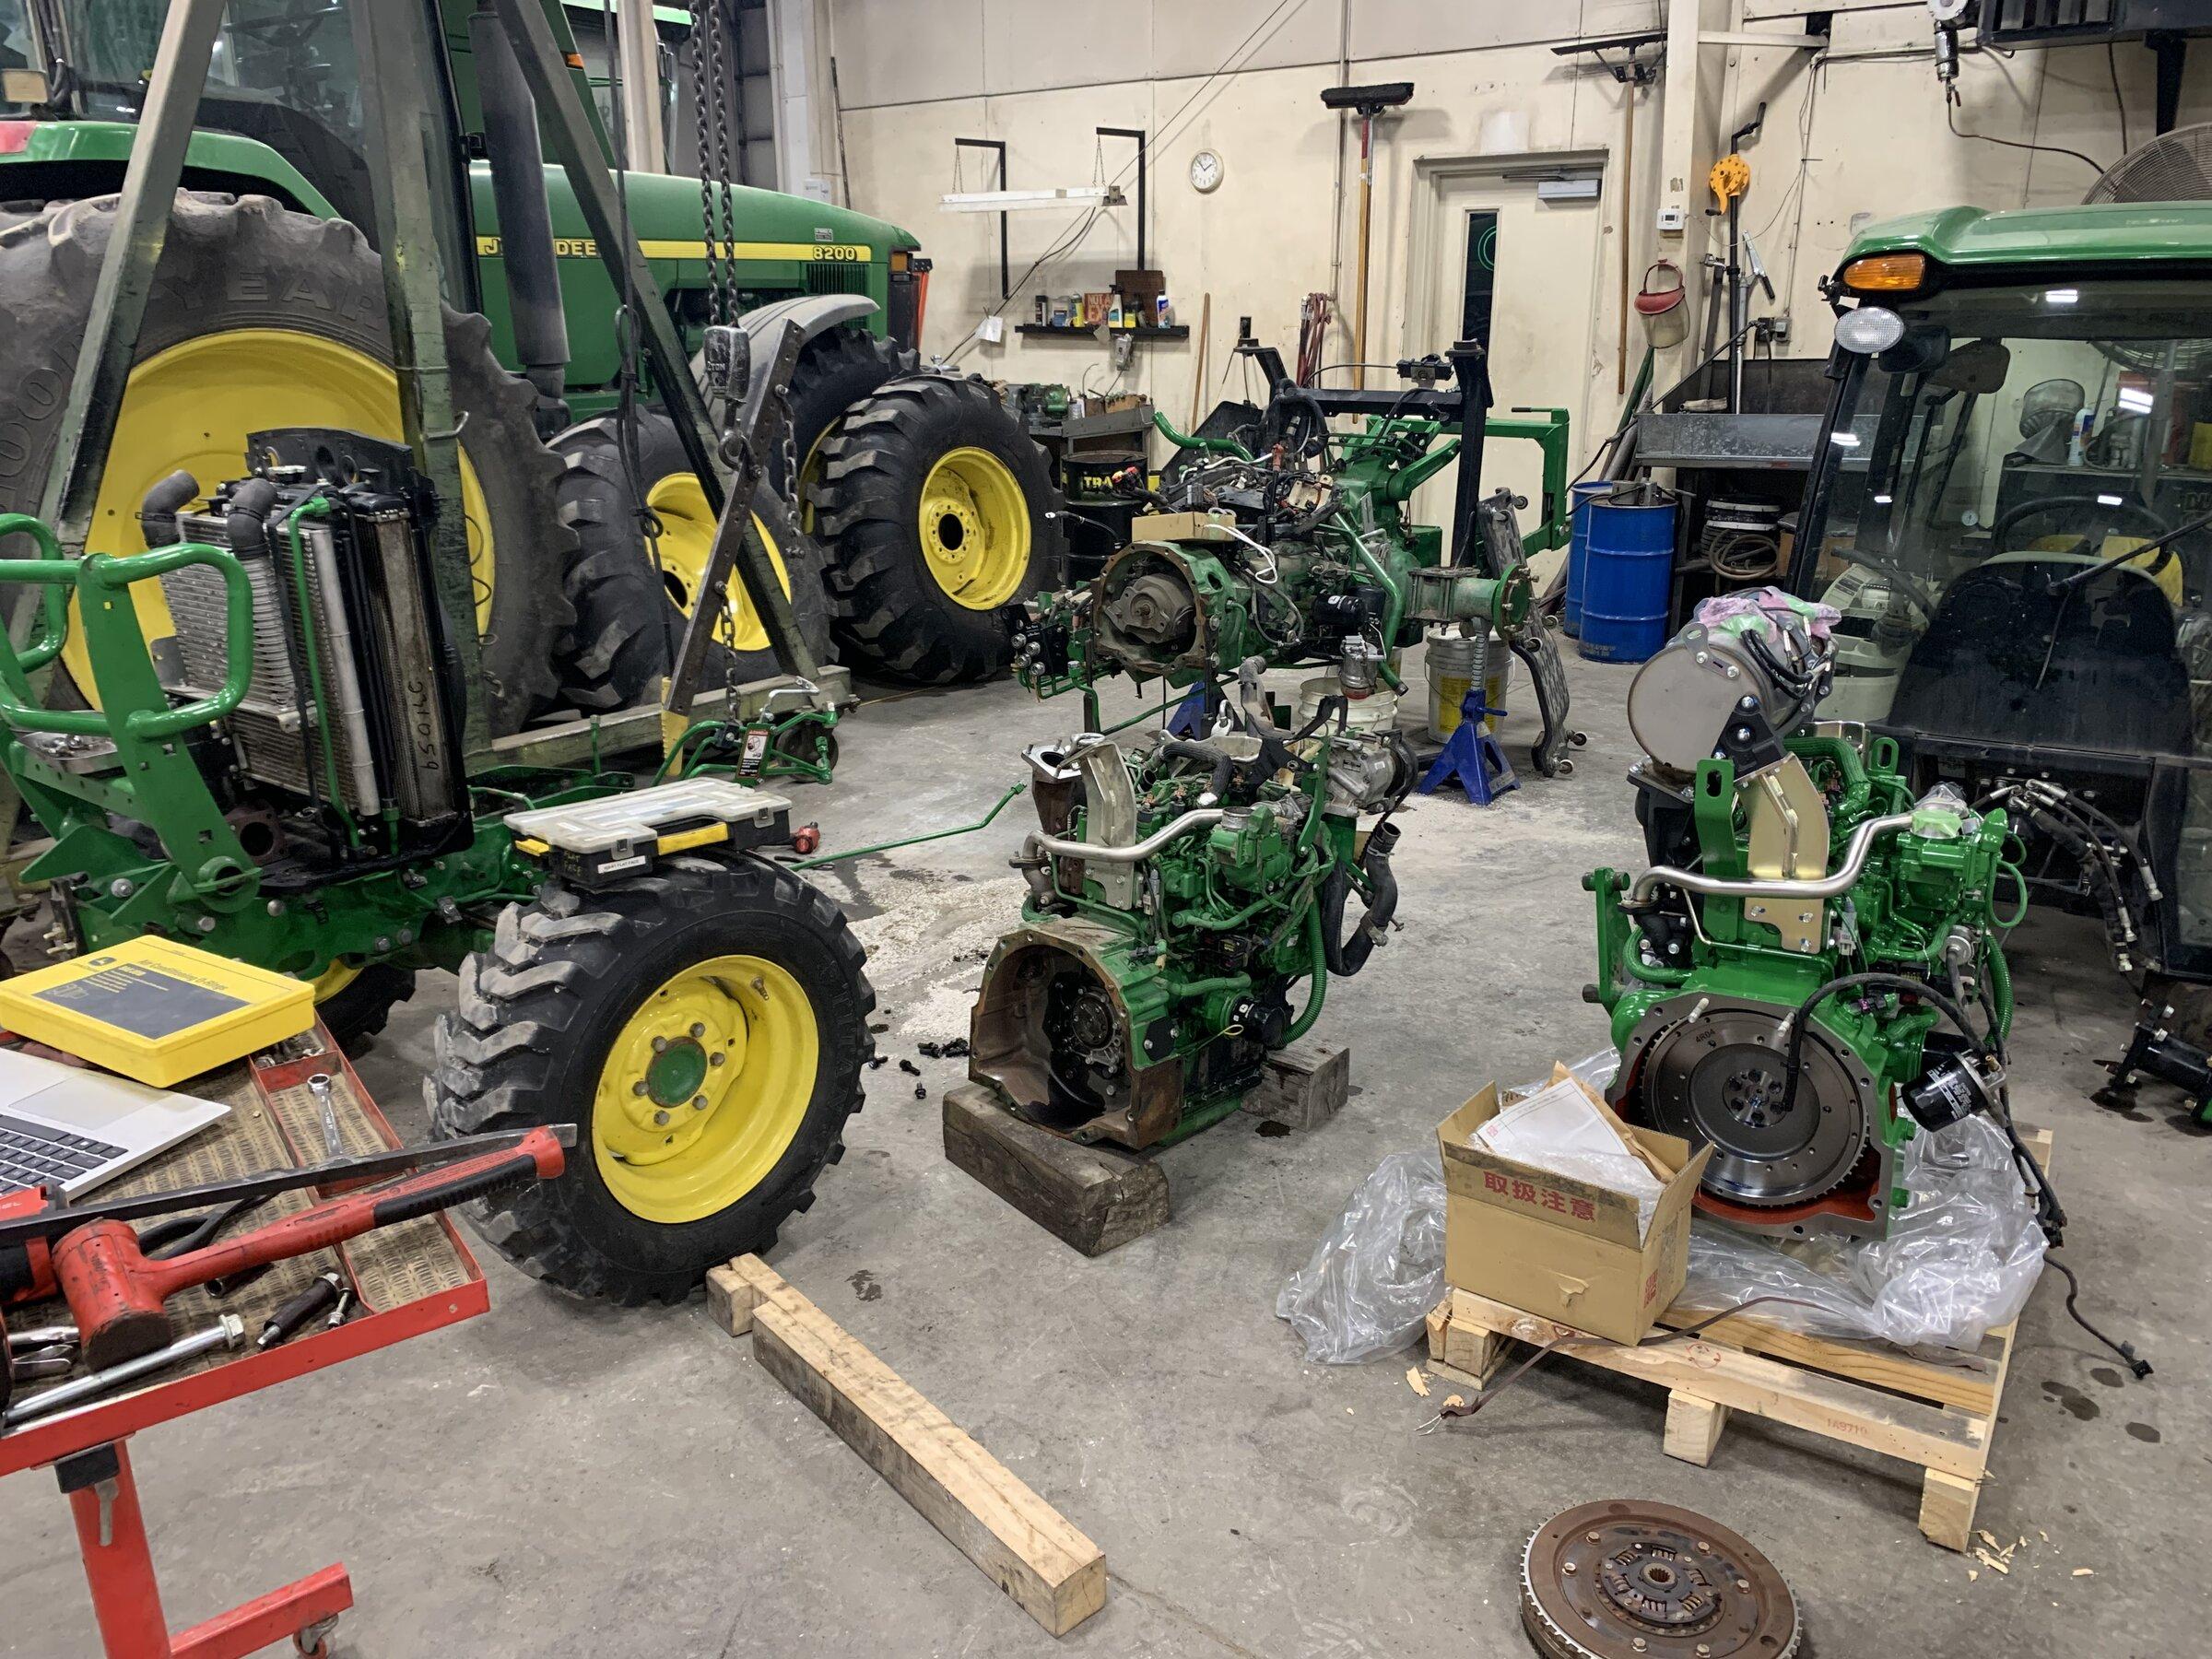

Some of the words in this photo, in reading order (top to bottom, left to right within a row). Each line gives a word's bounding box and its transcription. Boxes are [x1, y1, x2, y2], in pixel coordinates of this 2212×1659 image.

[555, 240, 597, 257] DEE
[813, 246, 857, 261] 8200
[1483, 1171, 1595, 1222] 取扱注意
